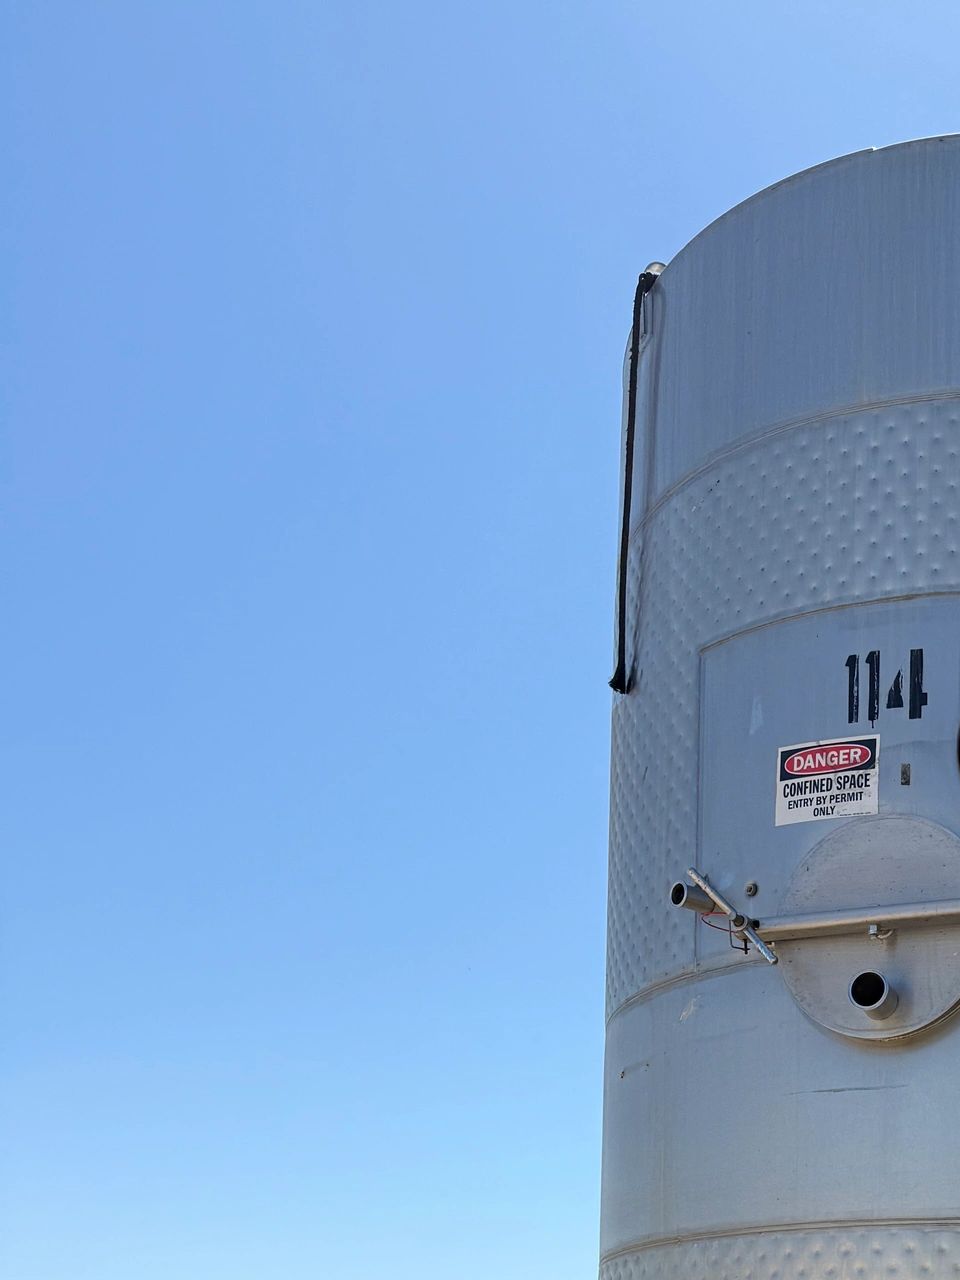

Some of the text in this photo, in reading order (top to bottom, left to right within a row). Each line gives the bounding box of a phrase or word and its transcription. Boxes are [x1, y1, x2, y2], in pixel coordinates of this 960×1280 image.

[845, 649, 928, 729] 114
[793, 747, 862, 772] DANGER
[783, 773, 871, 799] CONFINED SPACE
[787, 791, 864, 810] ENTRY BY PERMIT
[813, 805, 836, 817] ONLY
